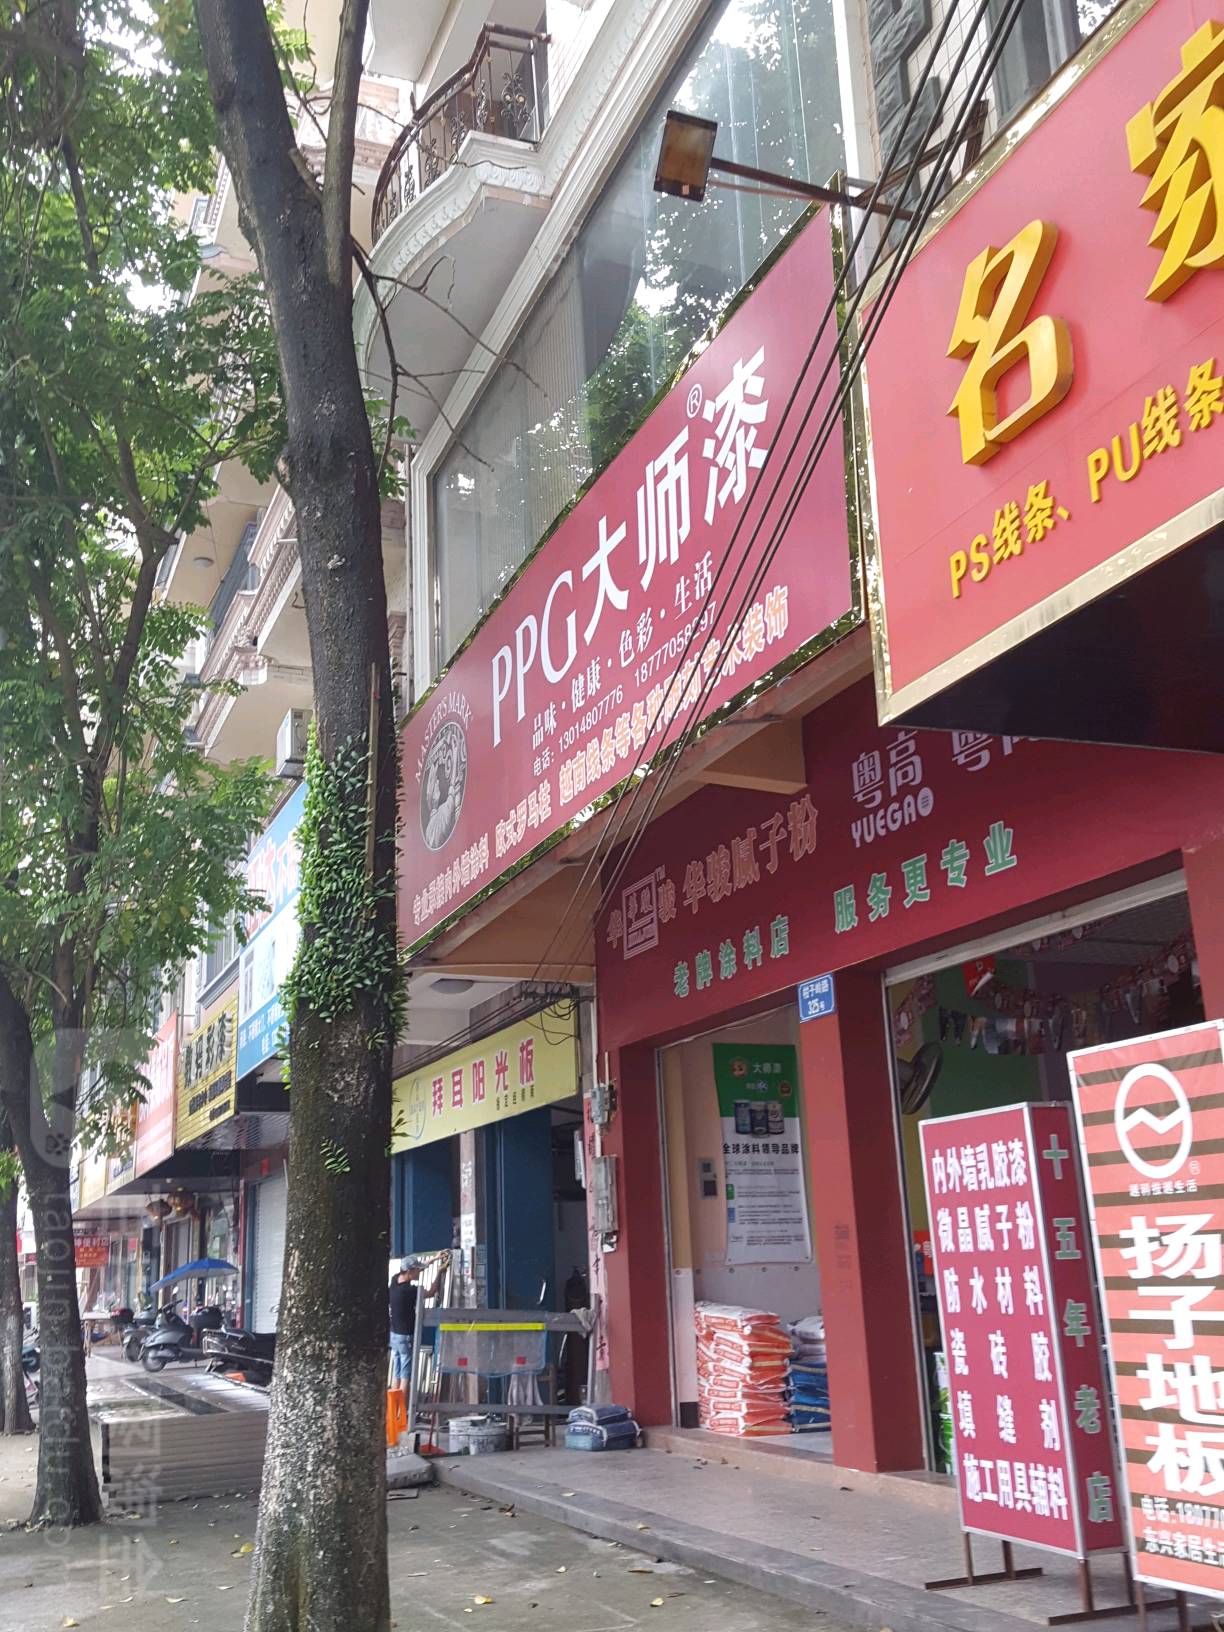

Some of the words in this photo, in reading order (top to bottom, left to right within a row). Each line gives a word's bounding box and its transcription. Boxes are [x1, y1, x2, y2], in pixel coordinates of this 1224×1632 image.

[491, 346, 769, 748] PPG大师漆
[447, 690, 473, 731] MARK
[558, 684, 624, 755] 13014807776
[851, 729, 924, 809] 粤高
[833, 820, 1018, 934] 服务更专业
[673, 914, 790, 998] 老牌涂料店
[431, 1038, 536, 1118] 拜耳阳光板
[931, 1138, 1028, 1195] 内外墙乳胶漆
[936, 1200, 1036, 1253] 微晶腻子粉
[943, 1265, 1044, 1316] 防水材料
[950, 1325, 1053, 1383] 瓷砖胶
[1043, 1134, 1113, 1524] 十五年老店
[1119, 1212, 1224, 1499] 扬子地板
[957, 1389, 1062, 1454] 填缝剂
[963, 1453, 1070, 1521] 施工用具辅料
